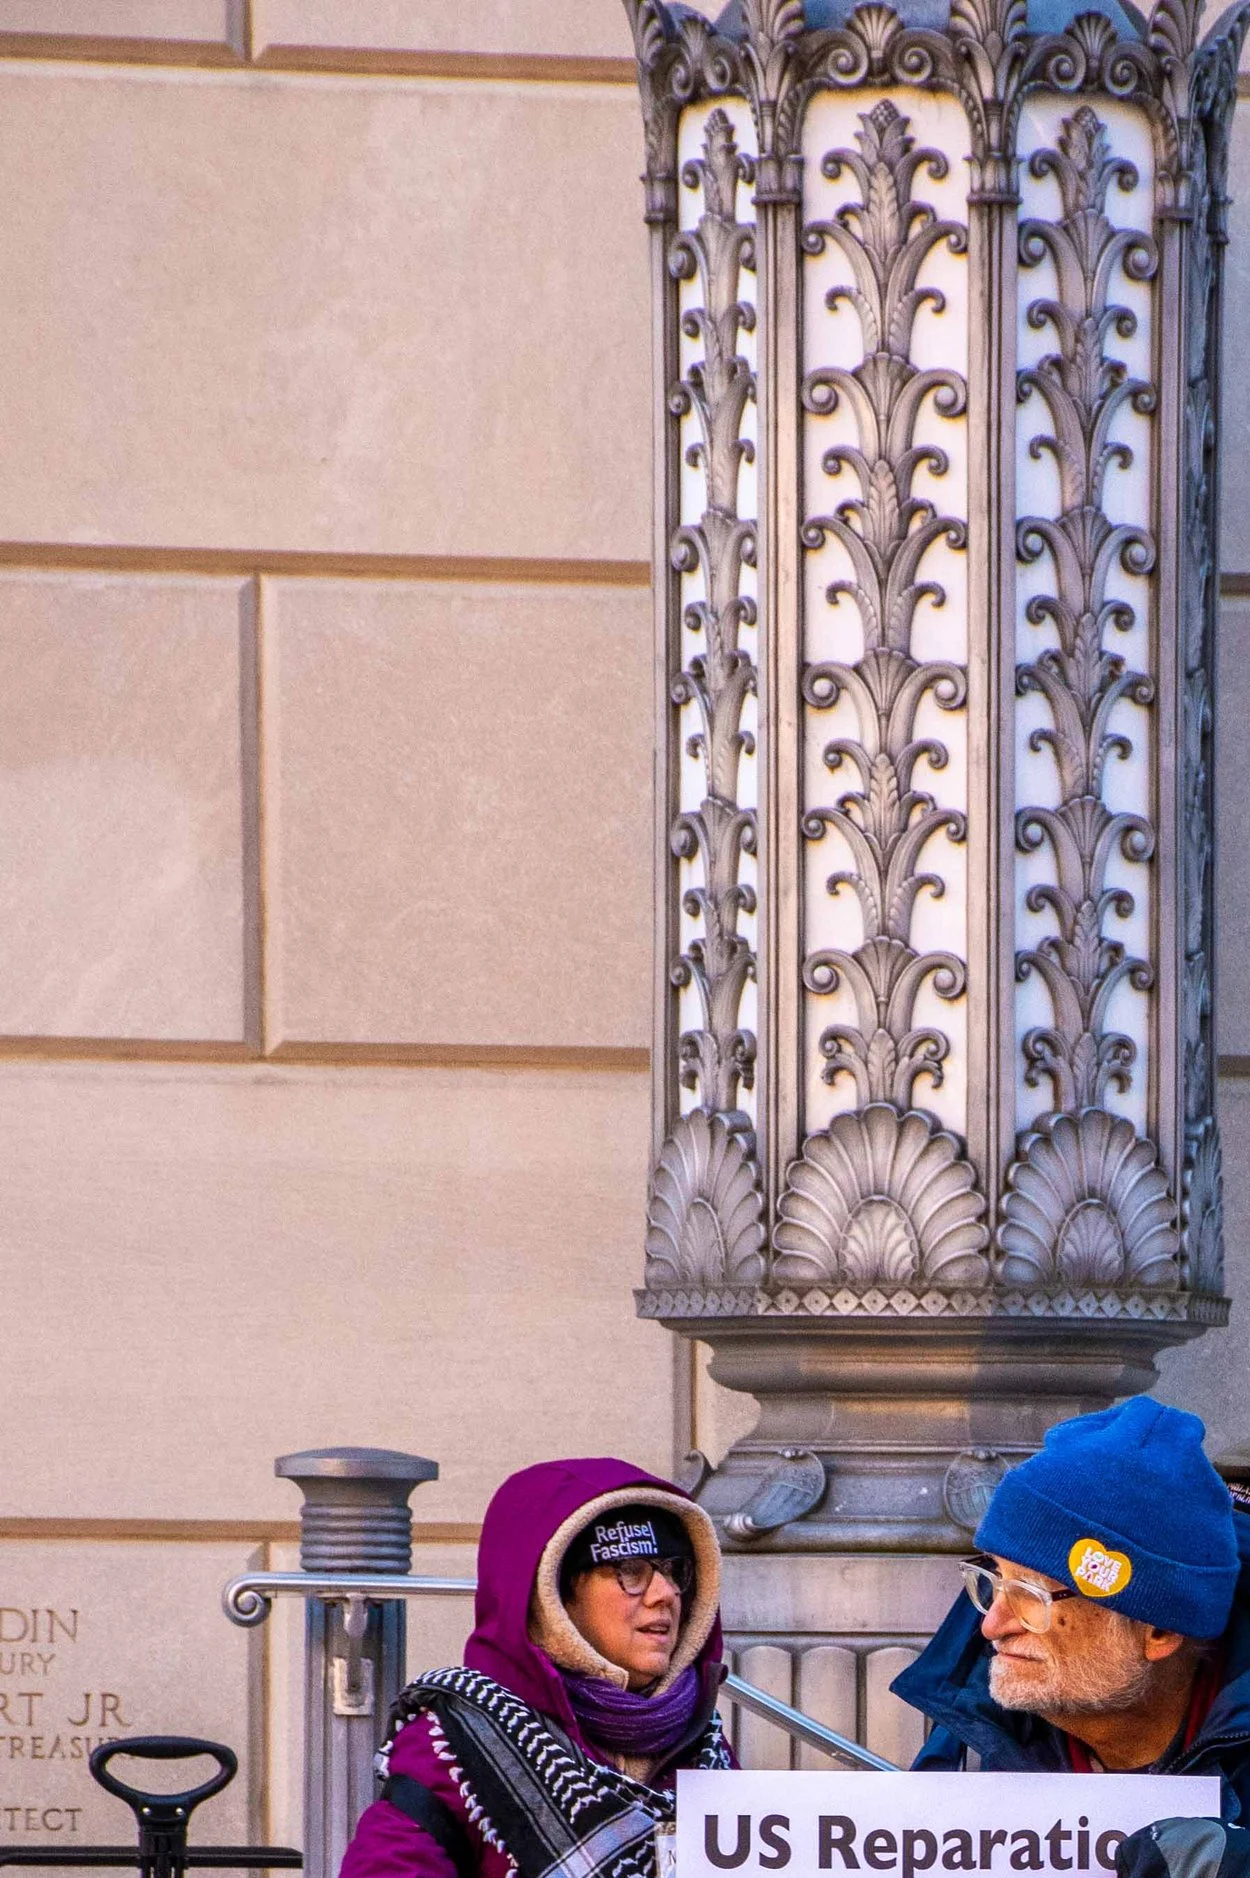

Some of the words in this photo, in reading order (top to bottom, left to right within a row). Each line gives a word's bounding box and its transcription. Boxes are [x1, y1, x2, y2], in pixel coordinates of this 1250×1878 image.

[1080, 1555, 1119, 1584] YOUR
[1083, 1546, 1122, 1571] LOVE
[1074, 1566, 1111, 1592] PARK
[67, 1692, 132, 1728] JR
[0, 1807, 83, 1832] TECT
[704, 1814, 791, 1870] US
